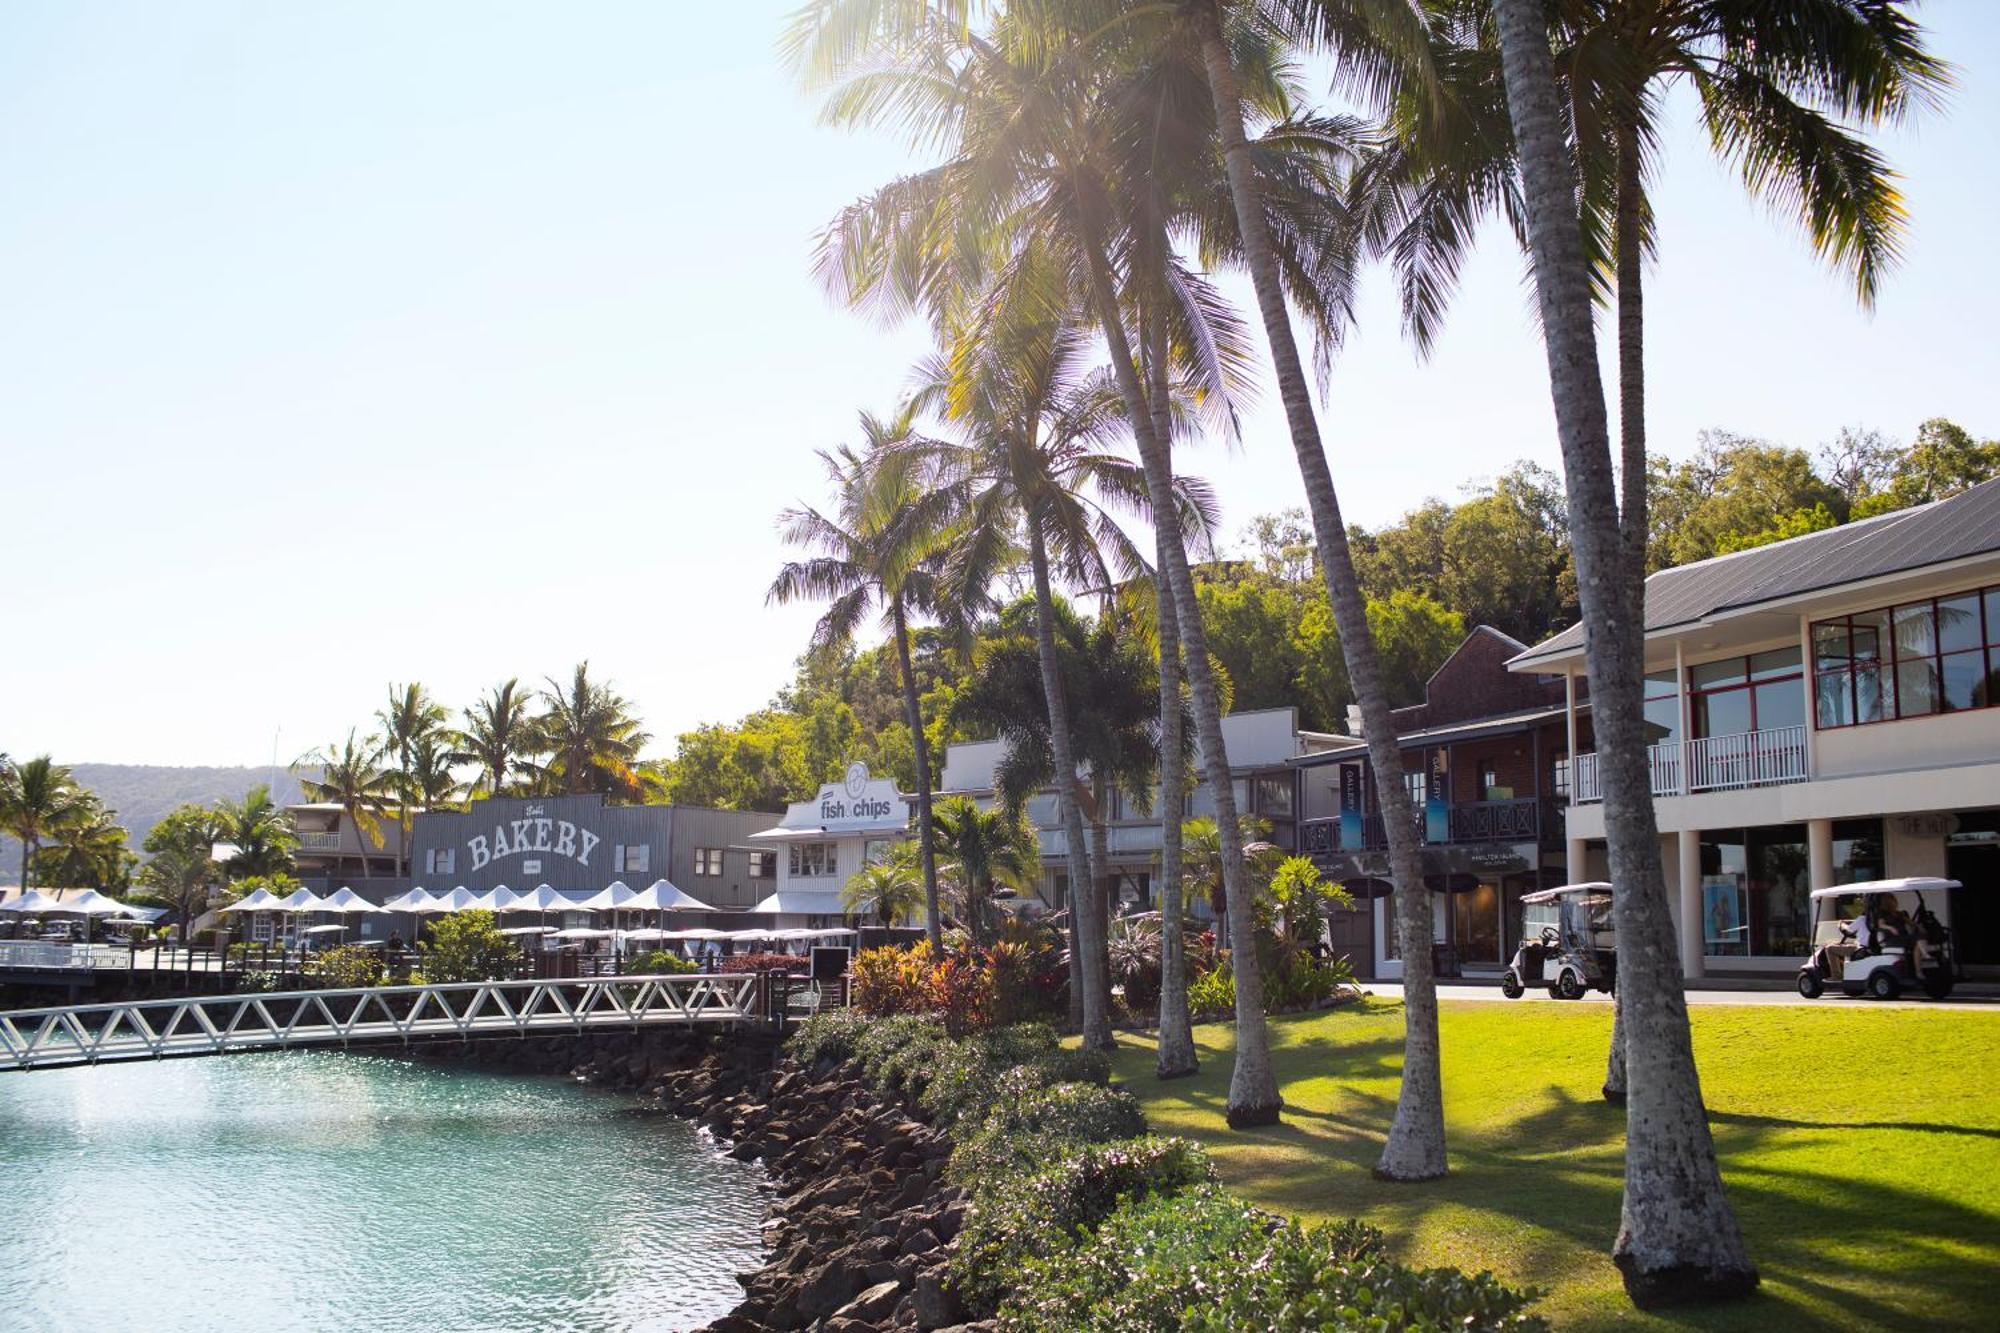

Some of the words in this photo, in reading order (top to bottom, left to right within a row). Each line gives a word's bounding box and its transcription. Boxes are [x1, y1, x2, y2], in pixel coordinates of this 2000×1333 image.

[1345, 770, 1355, 811] GALLERY
[1432, 756, 1441, 801] GALLERY
[821, 800, 845, 819] fish
[853, 797, 891, 820] chips
[467, 818, 601, 872] BAKERY
